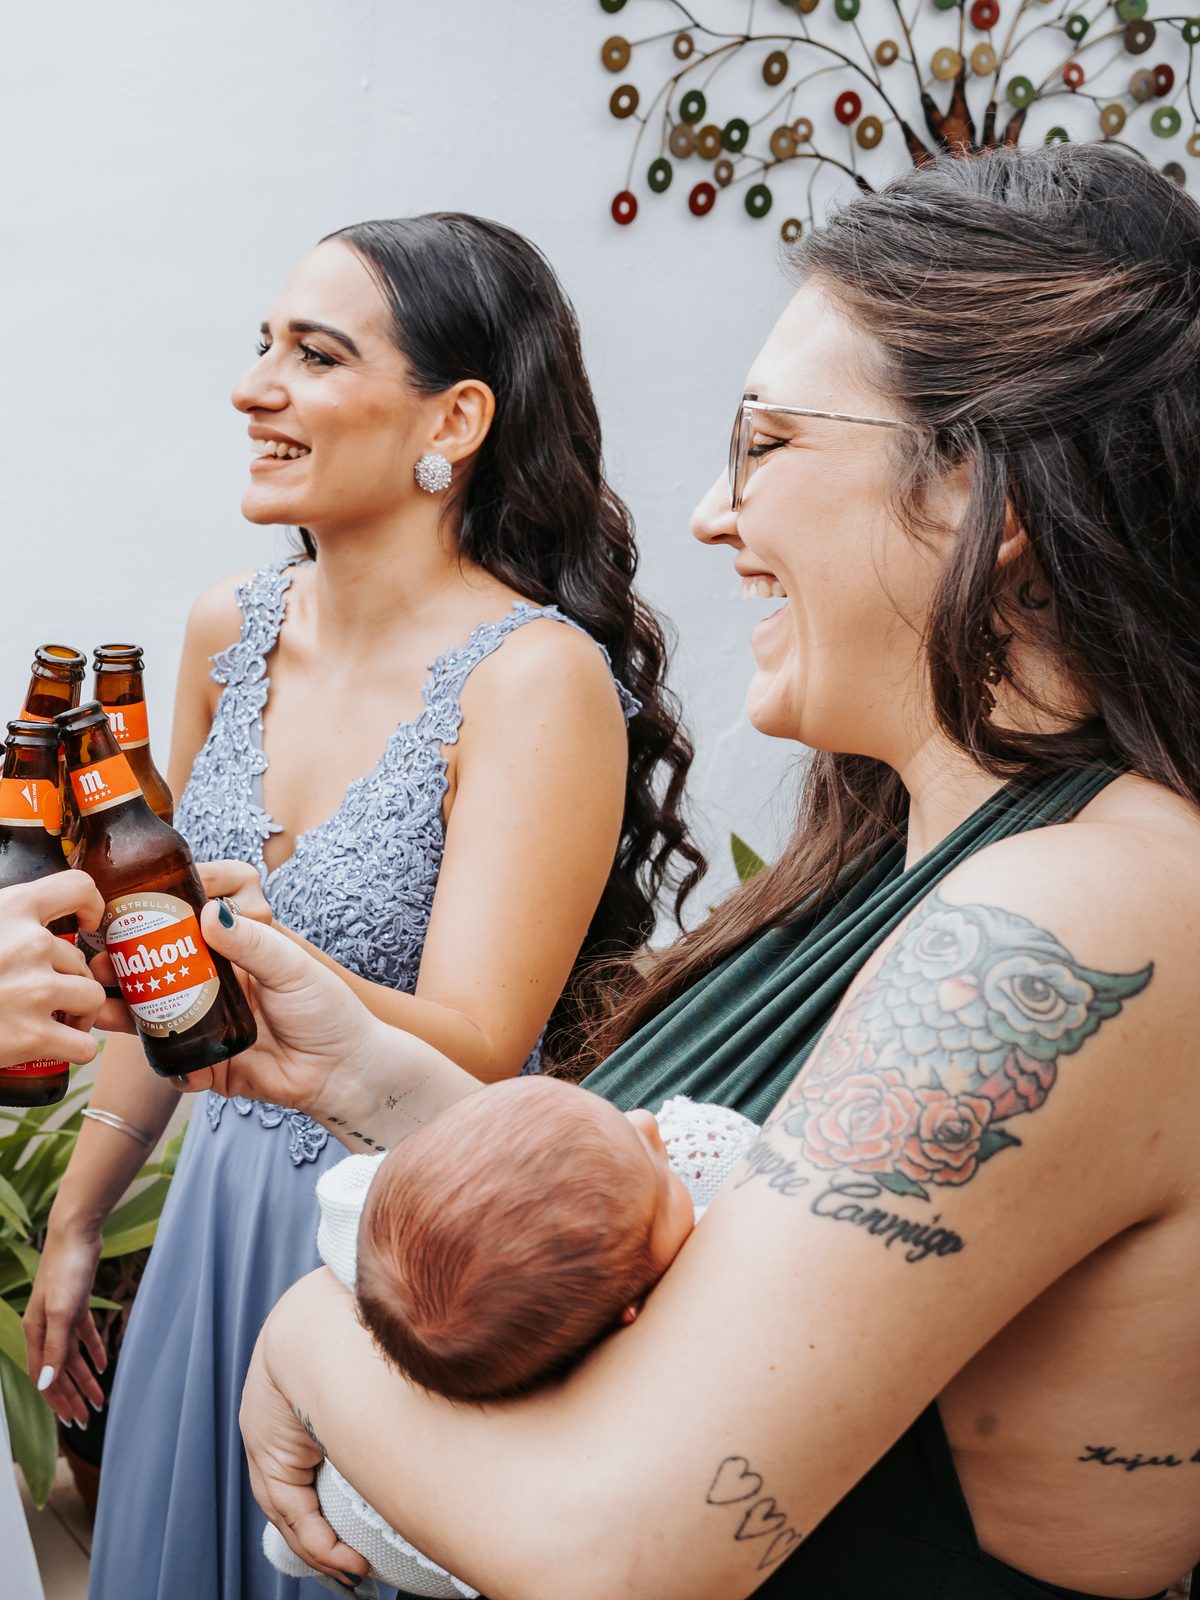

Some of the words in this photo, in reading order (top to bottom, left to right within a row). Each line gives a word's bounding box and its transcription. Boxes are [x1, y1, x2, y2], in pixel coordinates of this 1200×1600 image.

[115, 900, 177, 914] ESTRELLAS
[118, 914, 144, 928] 1890
[110, 935, 198, 978] Mahou
[147, 1002, 181, 1015] ESPECIAL
